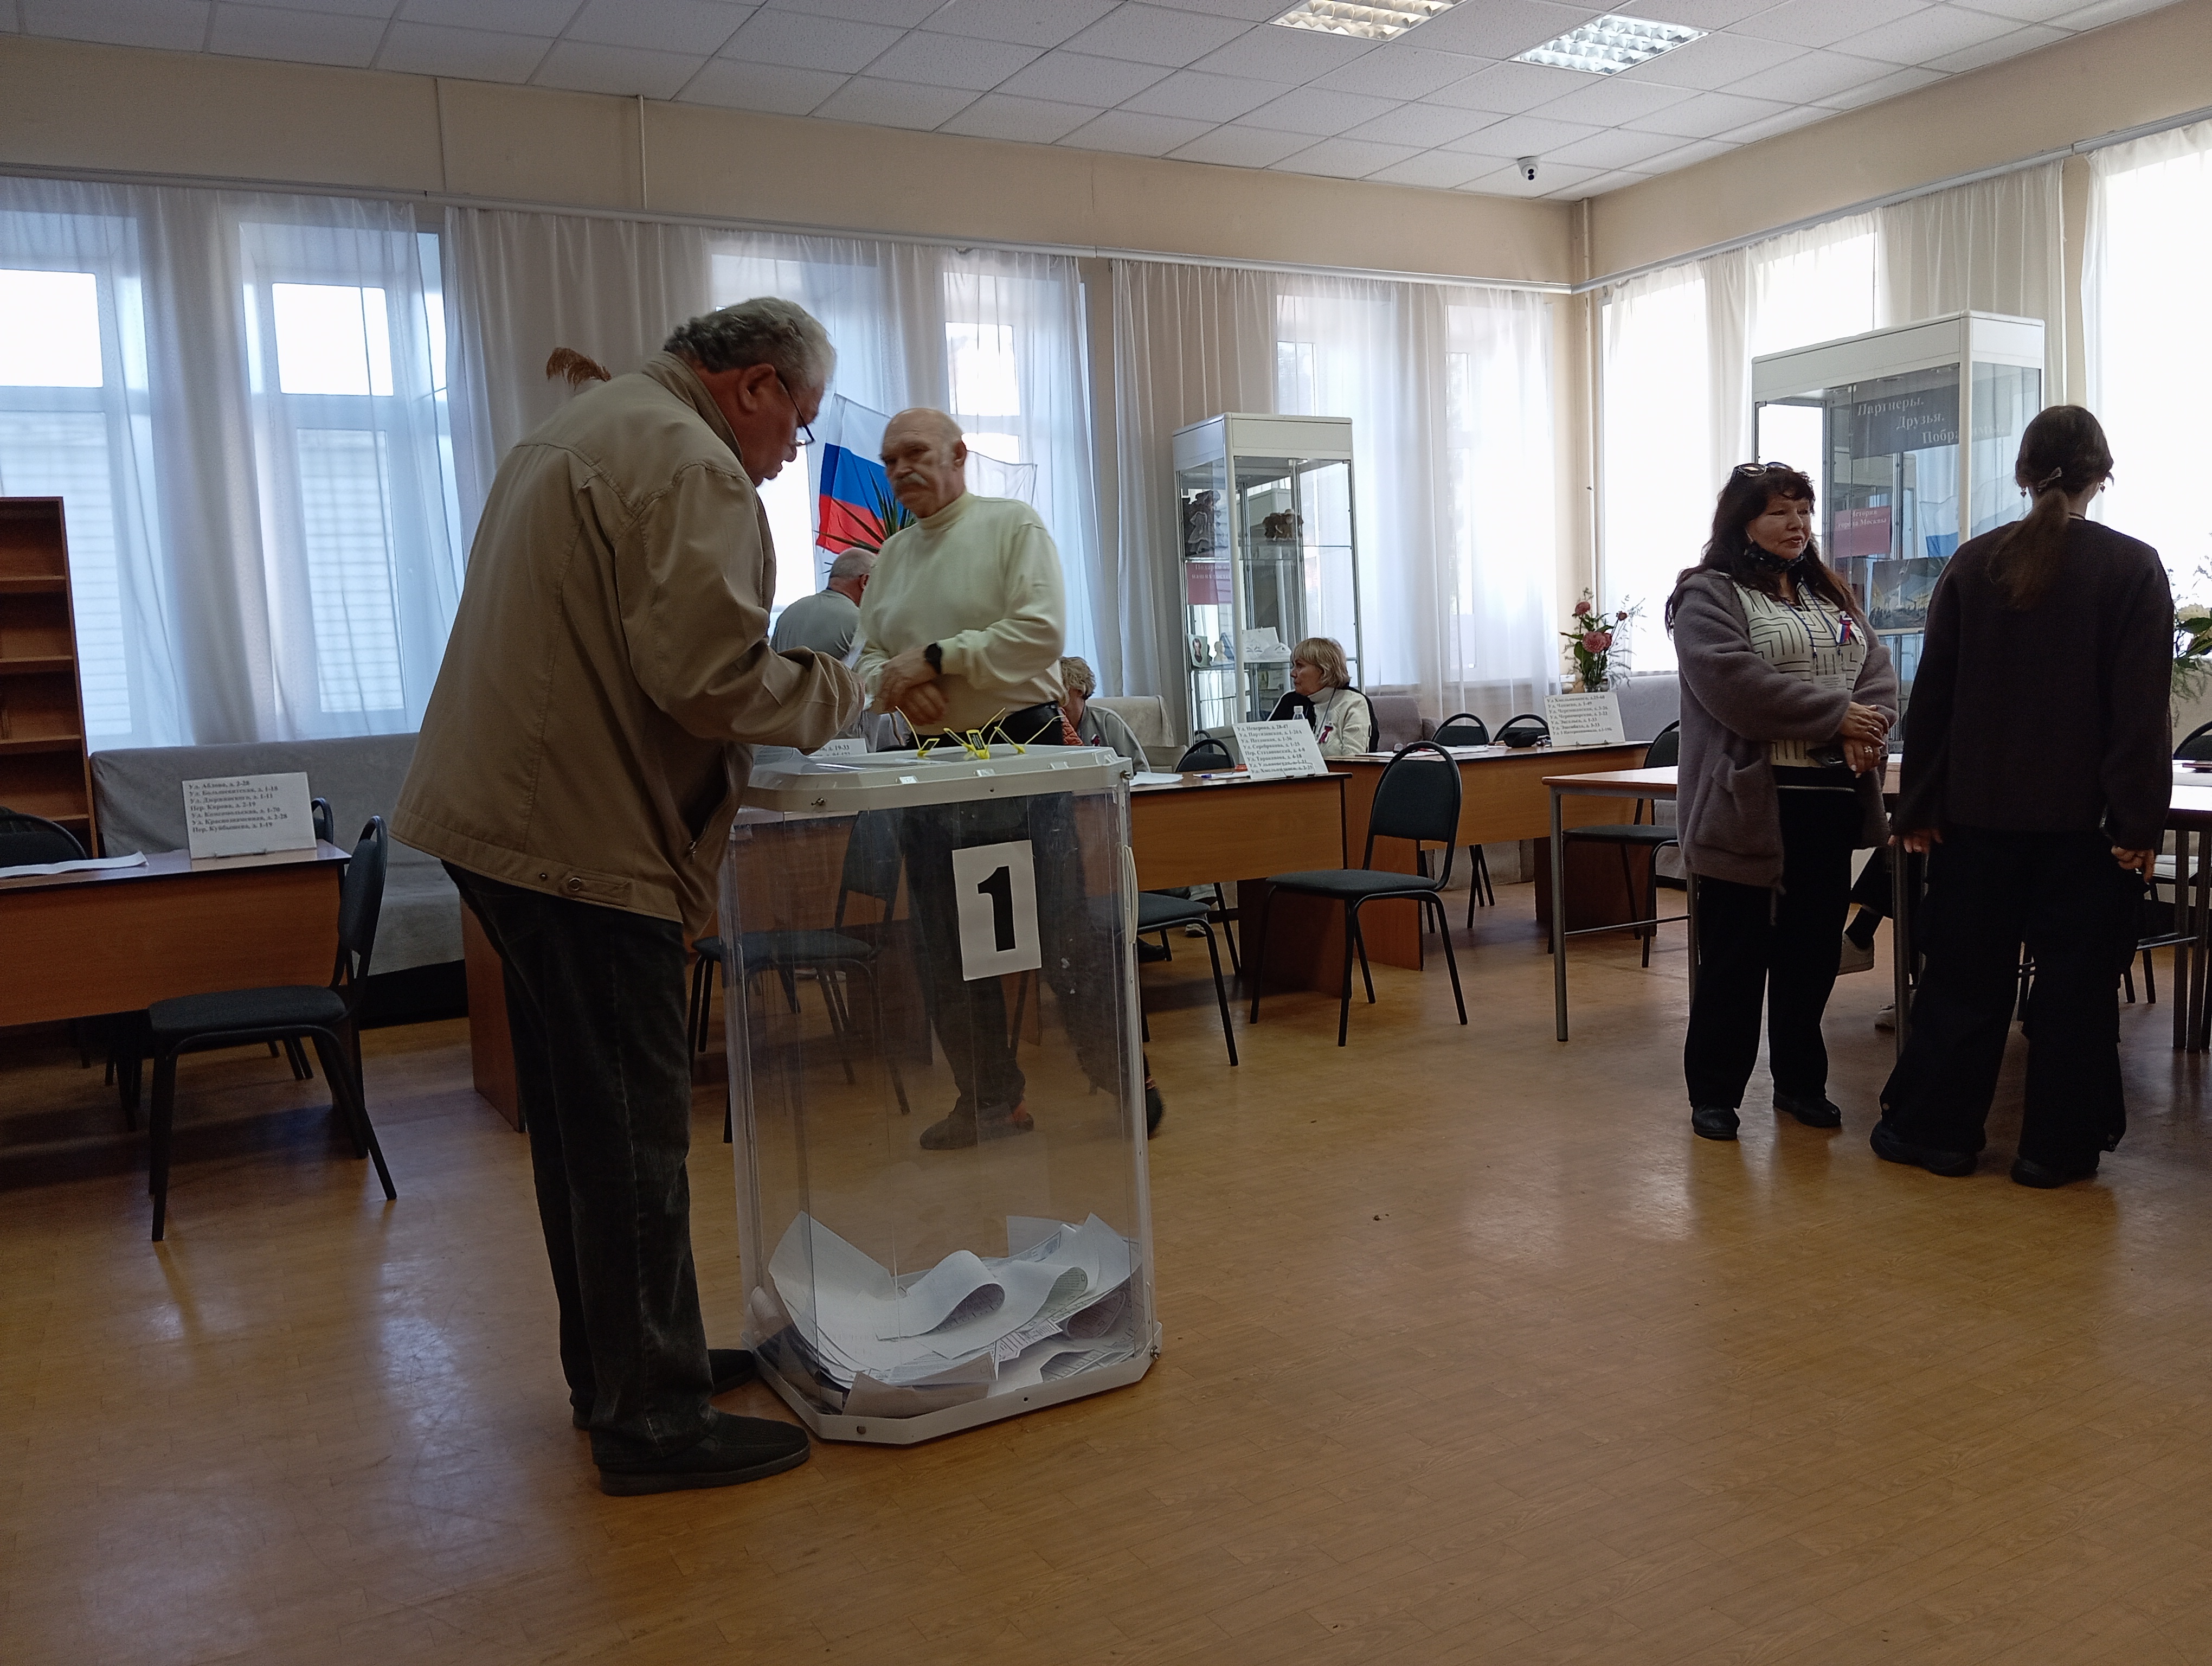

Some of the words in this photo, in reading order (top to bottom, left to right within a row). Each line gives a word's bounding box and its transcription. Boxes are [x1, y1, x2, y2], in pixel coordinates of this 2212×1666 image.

[1857, 396, 1924, 416] Партнеры.
[1896, 413, 1944, 430] Друзья.
[978, 866, 1016, 952] 1
